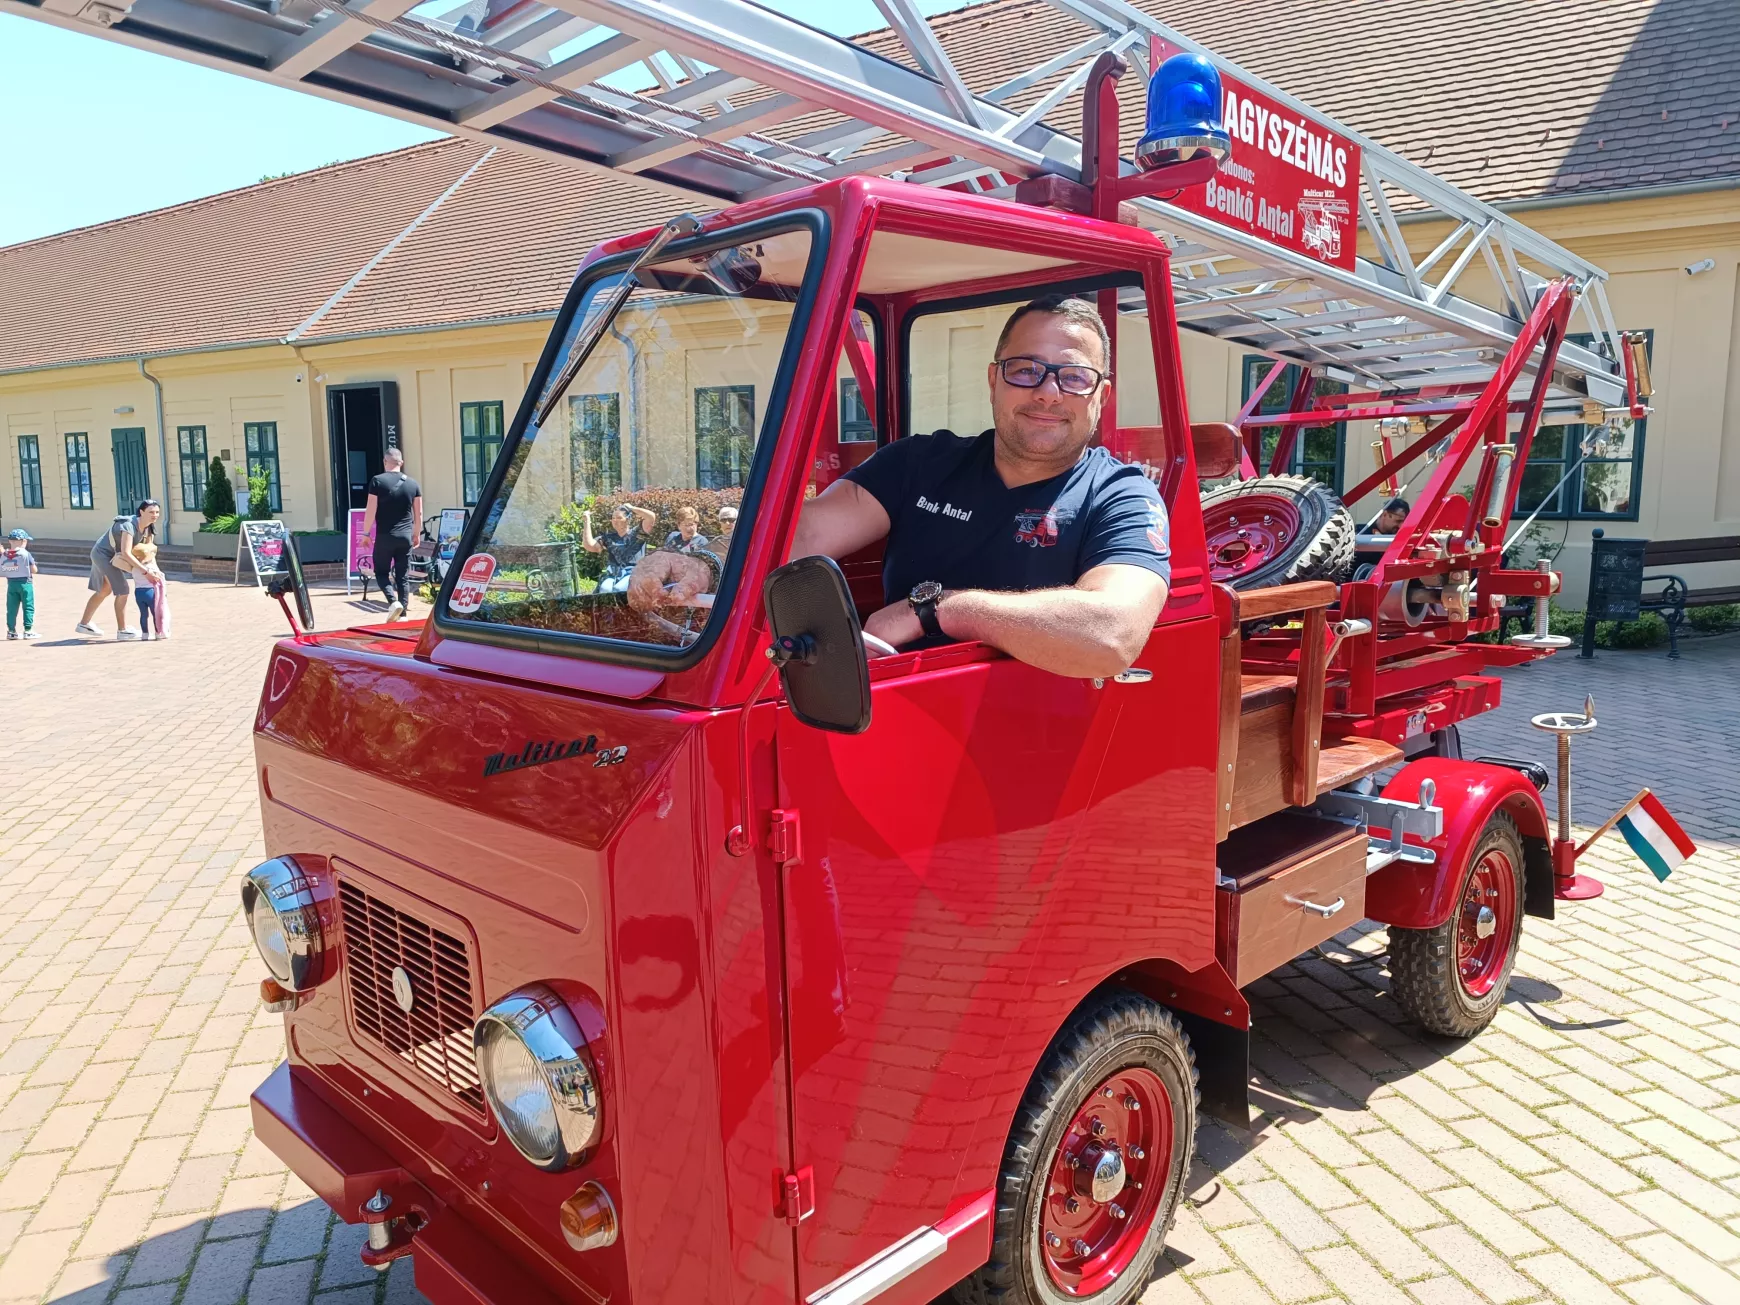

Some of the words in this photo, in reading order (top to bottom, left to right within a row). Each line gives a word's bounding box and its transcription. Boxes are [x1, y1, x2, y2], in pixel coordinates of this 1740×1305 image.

[1222, 88, 1347, 188] AGYSZÉNÁS
[1220, 158, 1255, 185] ajdonos:
[1206, 177, 1254, 223] Benkő
[1257, 197, 1294, 239] Antal
[387, 424, 398, 450] MÚZ
[942, 502, 973, 522] Antal
[458, 586, 477, 607] 25
[483, 734, 599, 778] Multicar
[592, 745, 629, 768] 22
